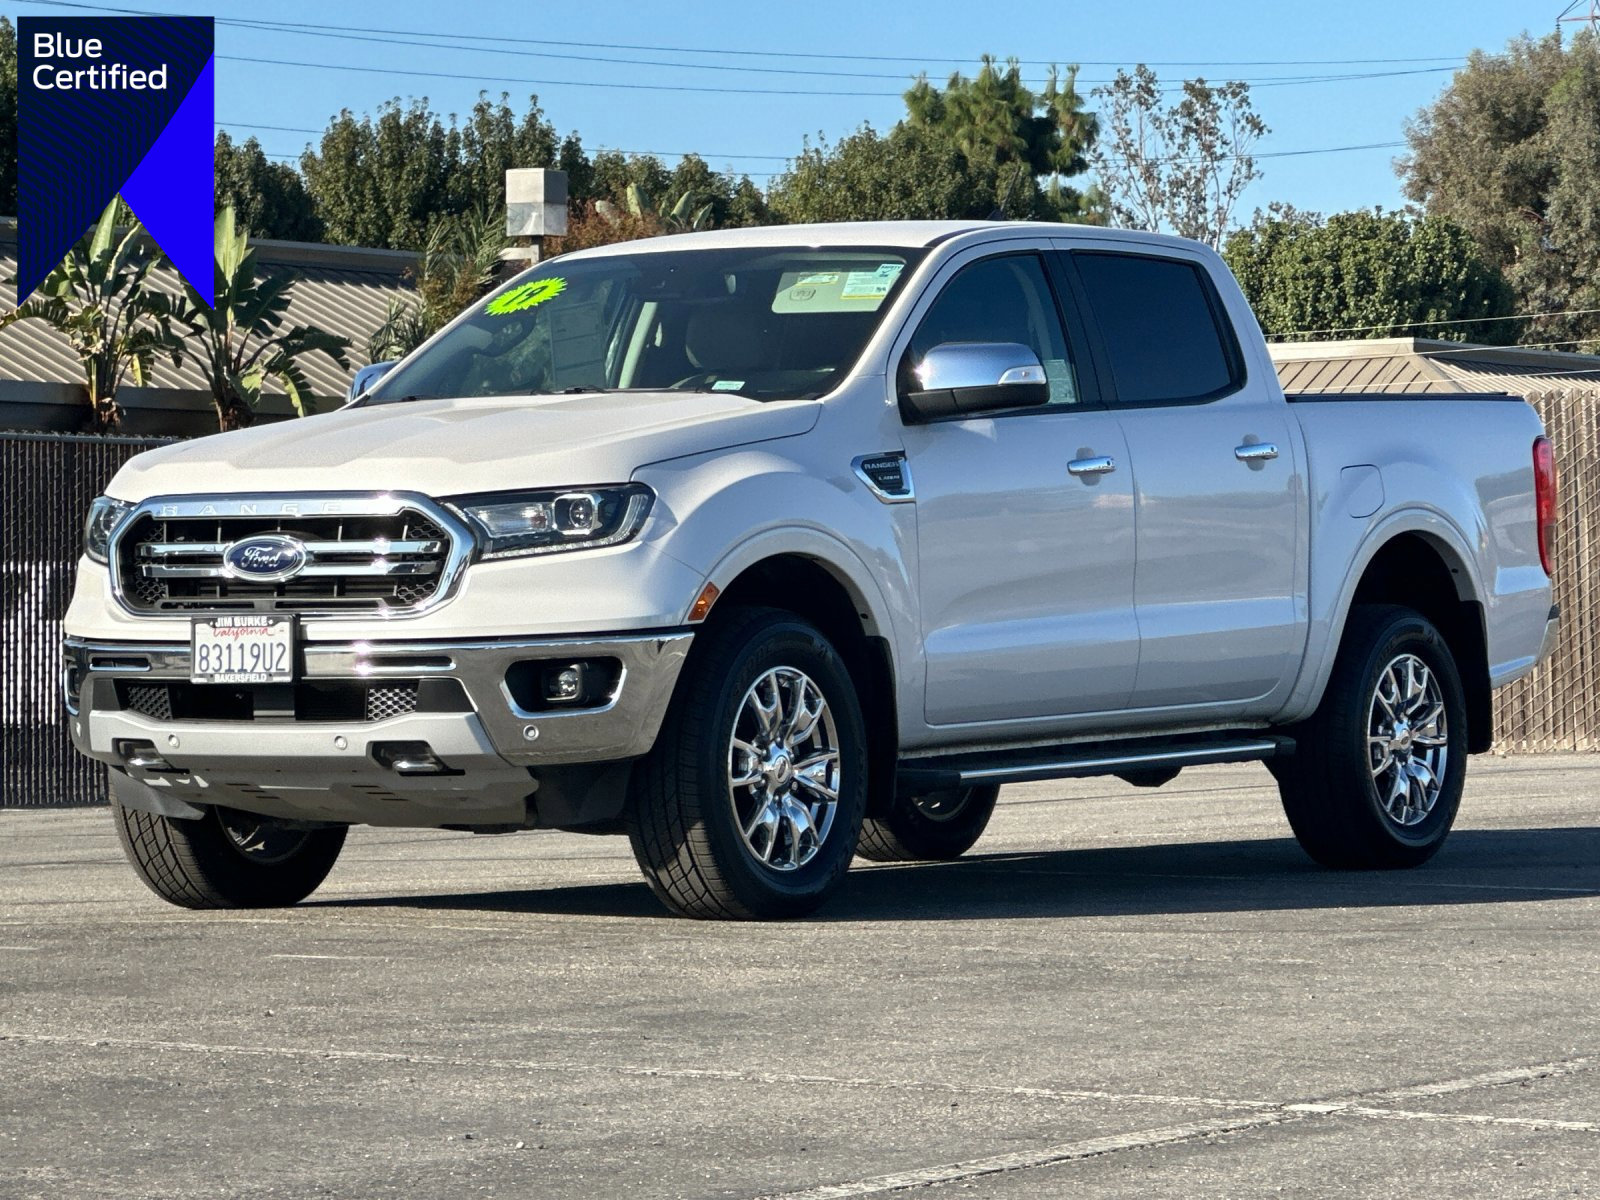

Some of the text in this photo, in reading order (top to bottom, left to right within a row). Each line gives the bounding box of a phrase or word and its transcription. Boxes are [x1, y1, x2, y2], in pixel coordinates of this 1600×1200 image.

[161, 502, 342, 516] RANGE
[241, 546, 282, 568] Ford
[215, 616, 268, 627] JIM BURKE
[213, 627, 275, 641] California
[199, 642, 286, 673] 83119U2
[214, 673, 267, 683] BAKERSFIELD
